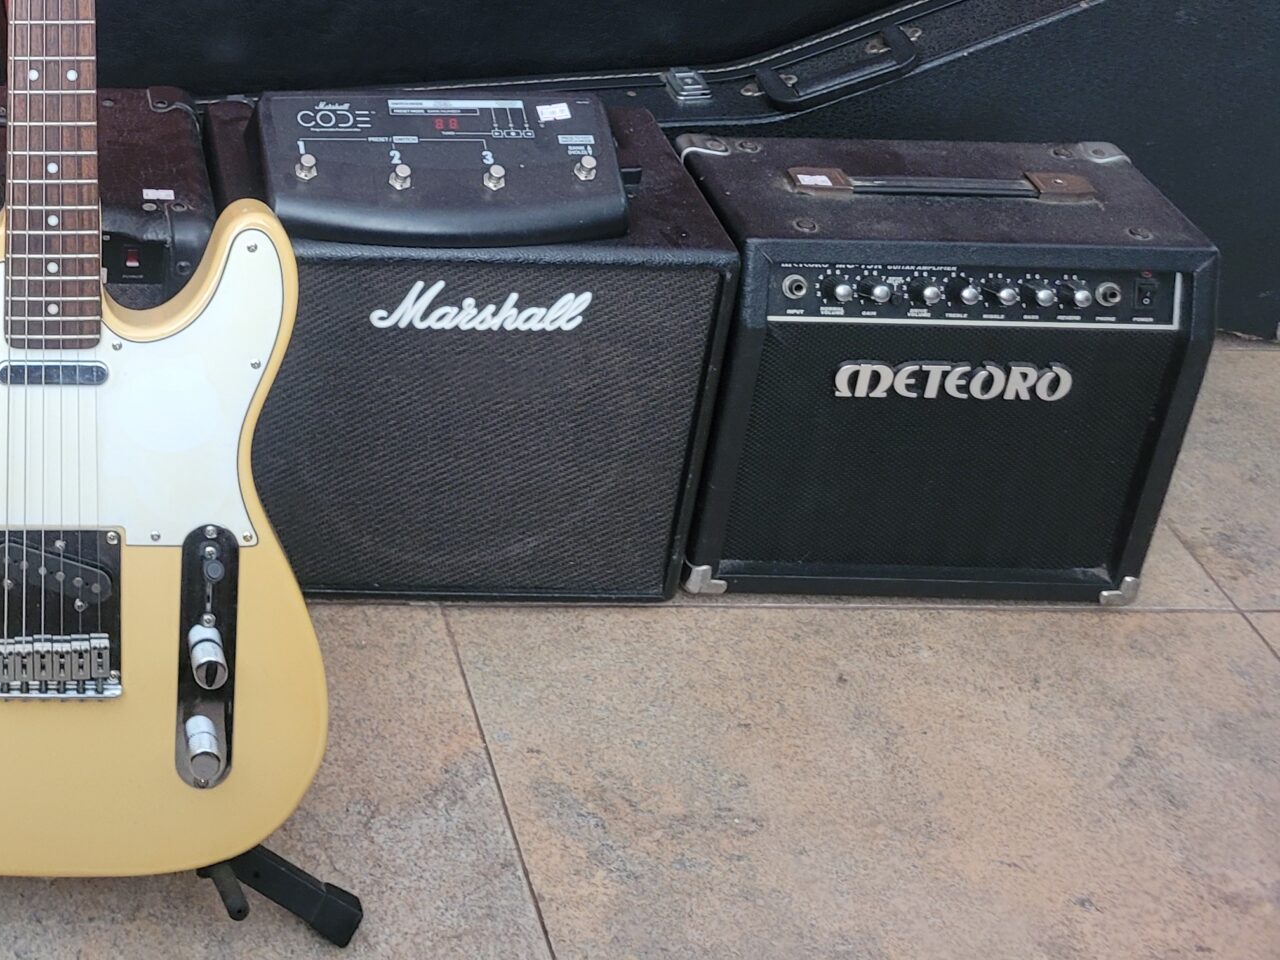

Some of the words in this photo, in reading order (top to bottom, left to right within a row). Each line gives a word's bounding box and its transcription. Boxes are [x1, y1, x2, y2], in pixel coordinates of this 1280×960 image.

[297, 110, 372, 127] CODE
[297, 141, 306, 154] 1
[389, 150, 402, 164] 2
[482, 150, 495, 165] 3
[369, 279, 593, 332] Marshall
[834, 359, 1073, 402] METEORO
